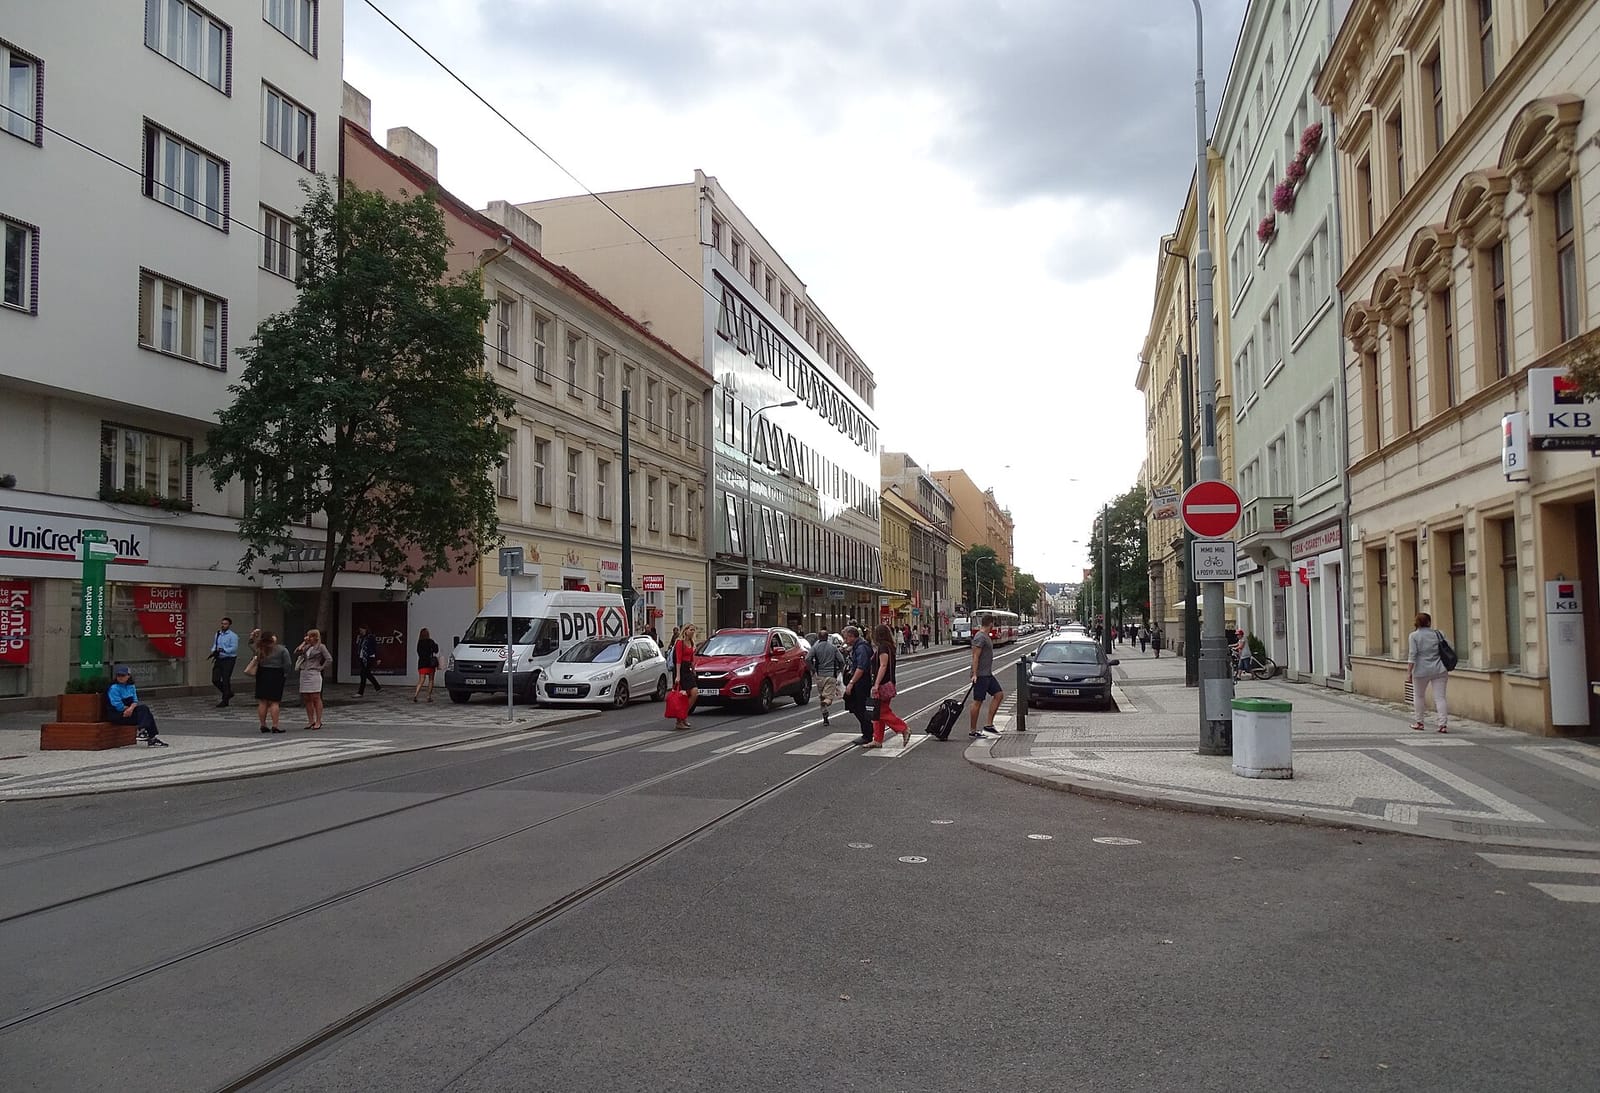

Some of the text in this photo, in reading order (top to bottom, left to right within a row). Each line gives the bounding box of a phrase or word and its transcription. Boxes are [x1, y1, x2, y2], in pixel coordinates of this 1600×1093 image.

[1549, 412, 1592, 428] KB
[107, 533, 141, 557] ank
[151, 588, 183, 599] Expert
[1556, 601, 1578, 610] KB
[10, 590, 29, 649] konto
[84, 585, 93, 637] Kooperativa
[560, 612, 597, 641] DPD
